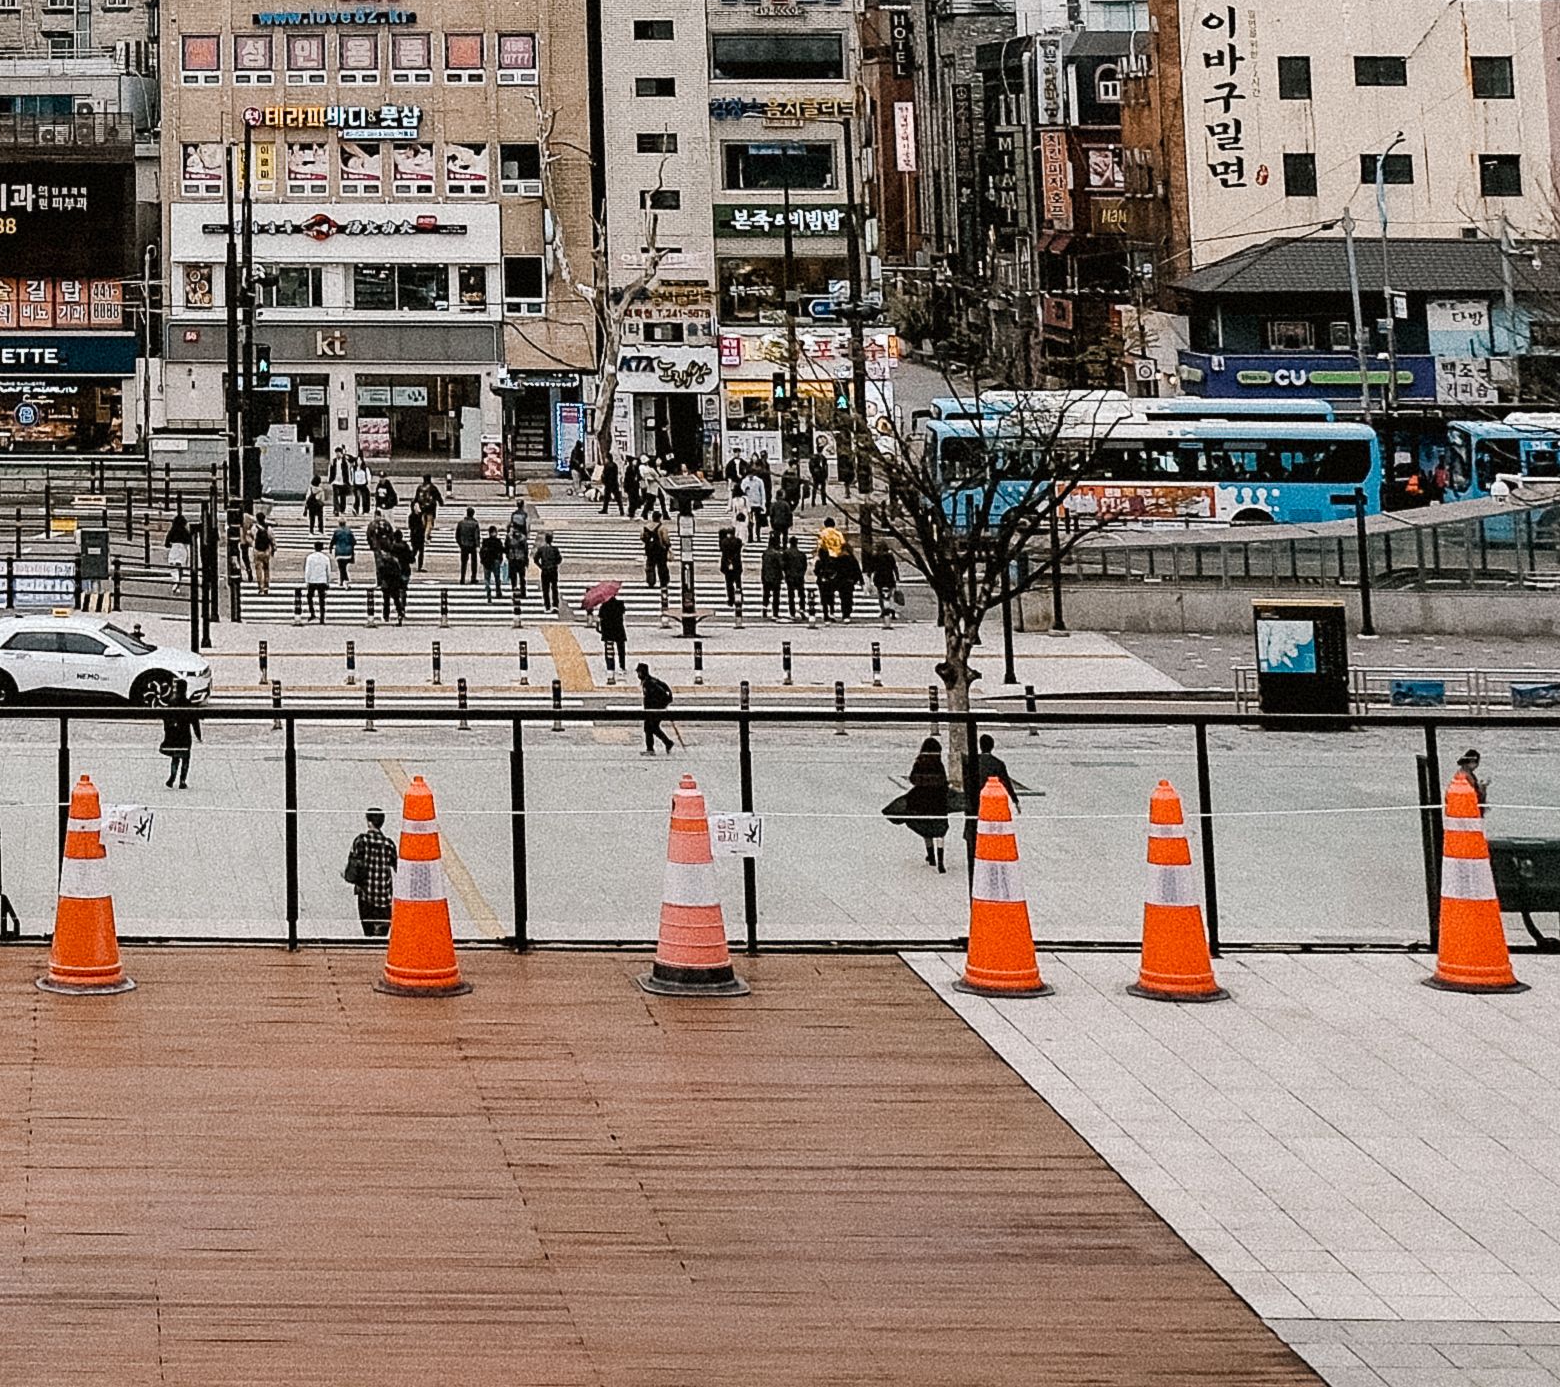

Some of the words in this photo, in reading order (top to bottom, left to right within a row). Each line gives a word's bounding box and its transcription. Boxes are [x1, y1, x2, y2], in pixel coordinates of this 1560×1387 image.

[241, 39, 428, 66] 성인용품
[894, 13, 908, 77] HOTEL
[1201, 5, 1247, 188] 이바구밀면
[1046, 134, 1066, 218] 치킨피자호프
[51, 196, 88, 212] 피부과
[24, 279, 83, 302] 길탑
[20, 304, 87, 323] 비뇨기과
[315, 329, 345, 356] kt
[619, 355, 657, 373] KTX
[1274, 368, 1306, 388] CU
